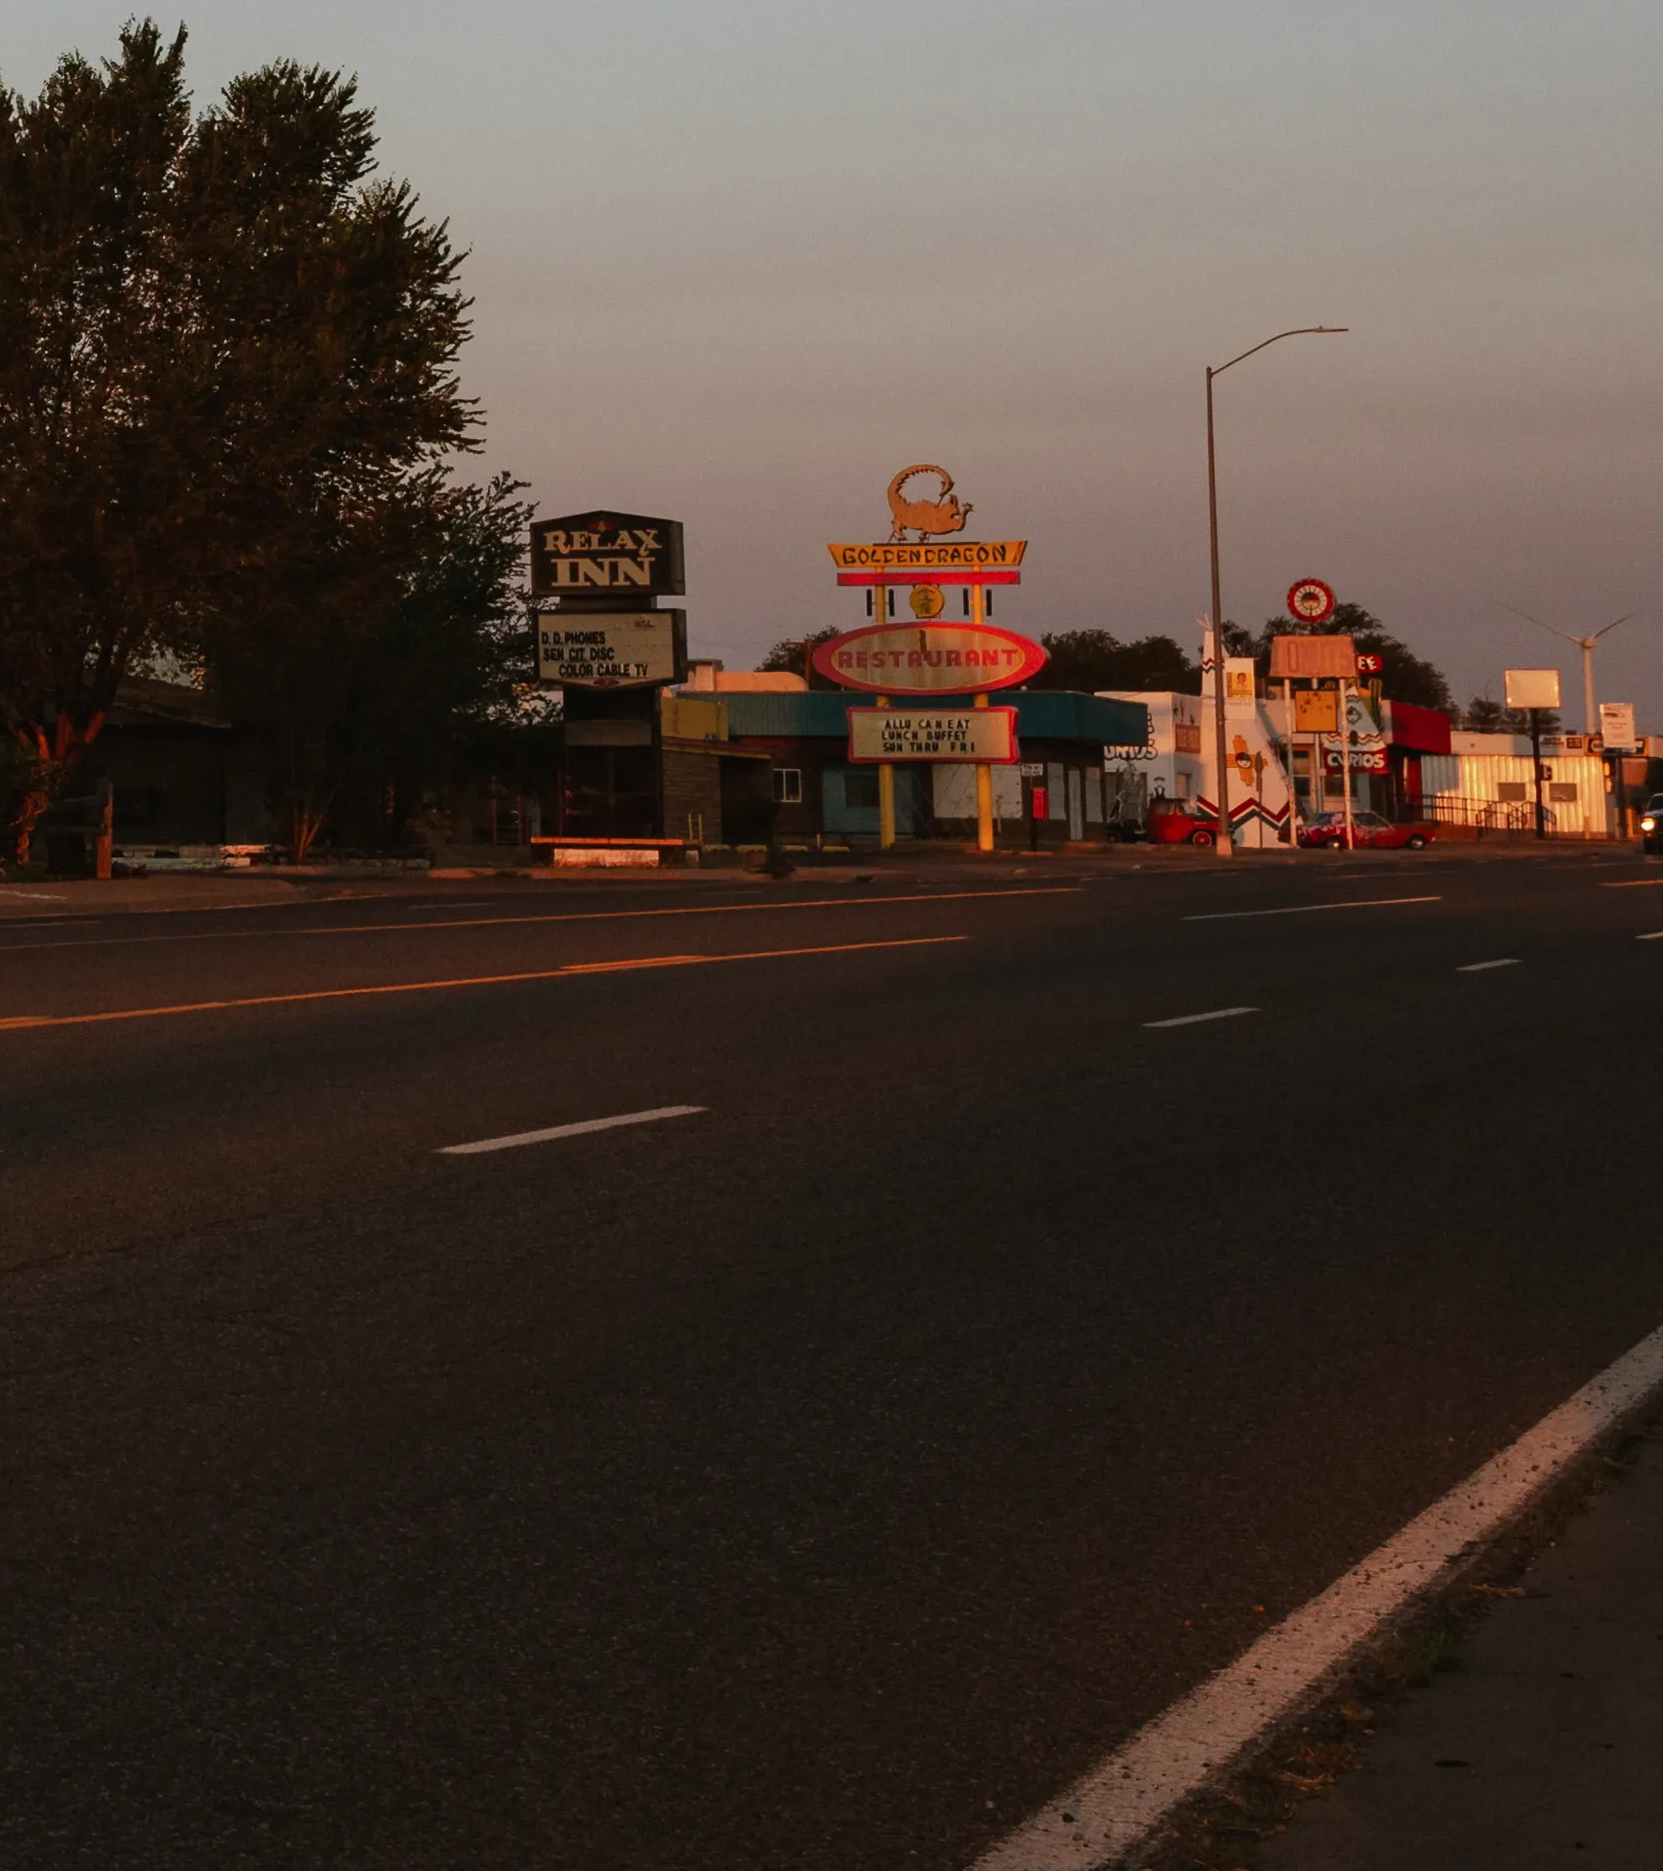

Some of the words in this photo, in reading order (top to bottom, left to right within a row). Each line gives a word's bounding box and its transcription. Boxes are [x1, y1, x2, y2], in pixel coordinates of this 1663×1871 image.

[543, 529, 662, 556] RELAX
[550, 557, 655, 587] INN
[590, 647, 615, 661] DISC
[837, 648, 1018, 670] RESTAURANT
[559, 664, 593, 677] COLOR
[597, 663, 630, 676] CABLE
[635, 663, 648, 676] TV
[881, 730, 918, 741] LUNCH
[926, 730, 966, 741] BUFFET
[883, 742, 903, 752] SUN
[909, 742, 939, 752] THRU
